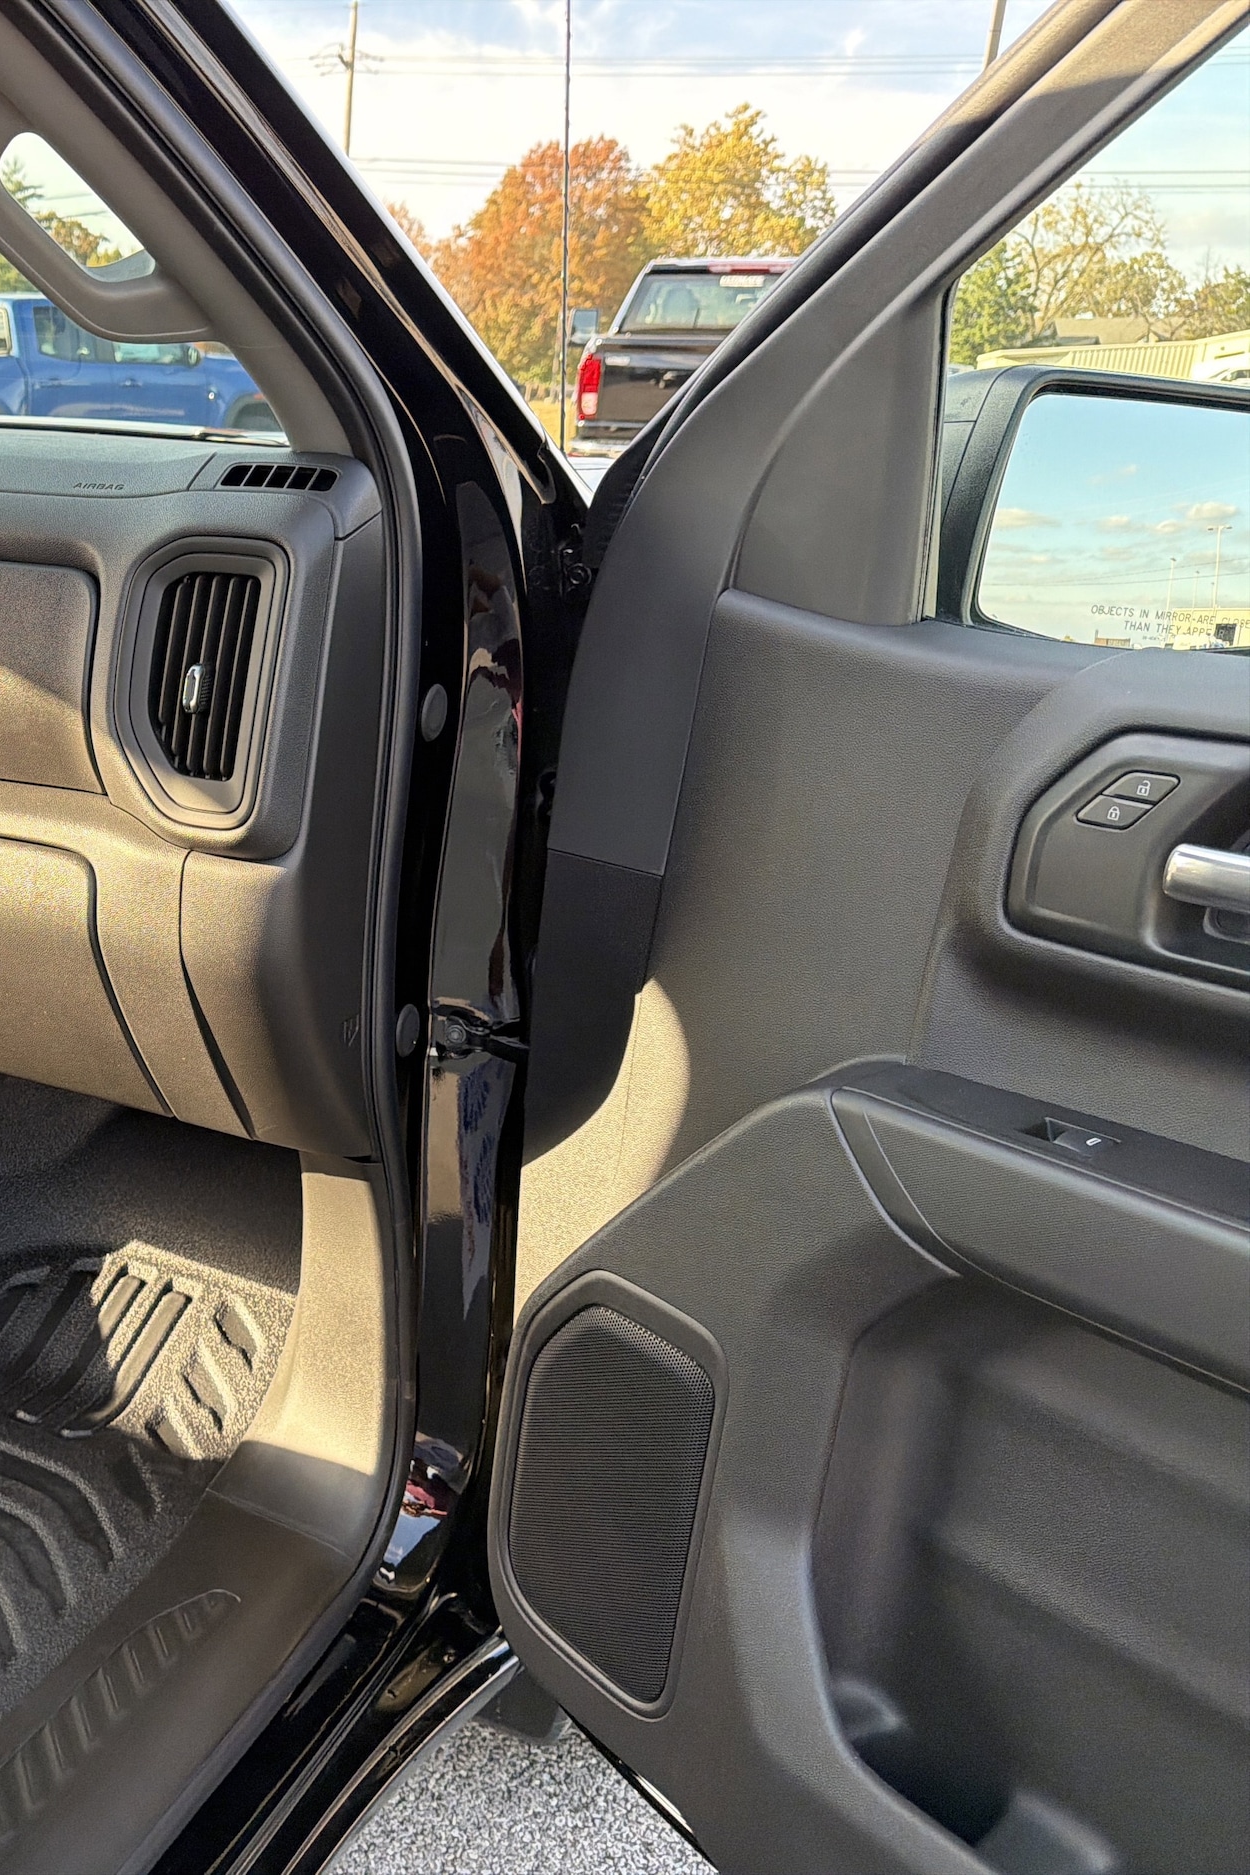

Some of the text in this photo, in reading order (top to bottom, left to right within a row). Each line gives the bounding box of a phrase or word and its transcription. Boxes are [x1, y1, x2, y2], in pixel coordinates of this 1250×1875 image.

[73, 482, 125, 491] AIRBAG
[1091, 604, 1135, 618] OBJECTS
[1139, 608, 1149, 618] IN
[1155, 610, 1192, 623] MIRROR
[1124, 620, 1150, 632] THAN
[1156, 622, 1182, 635] THEY
